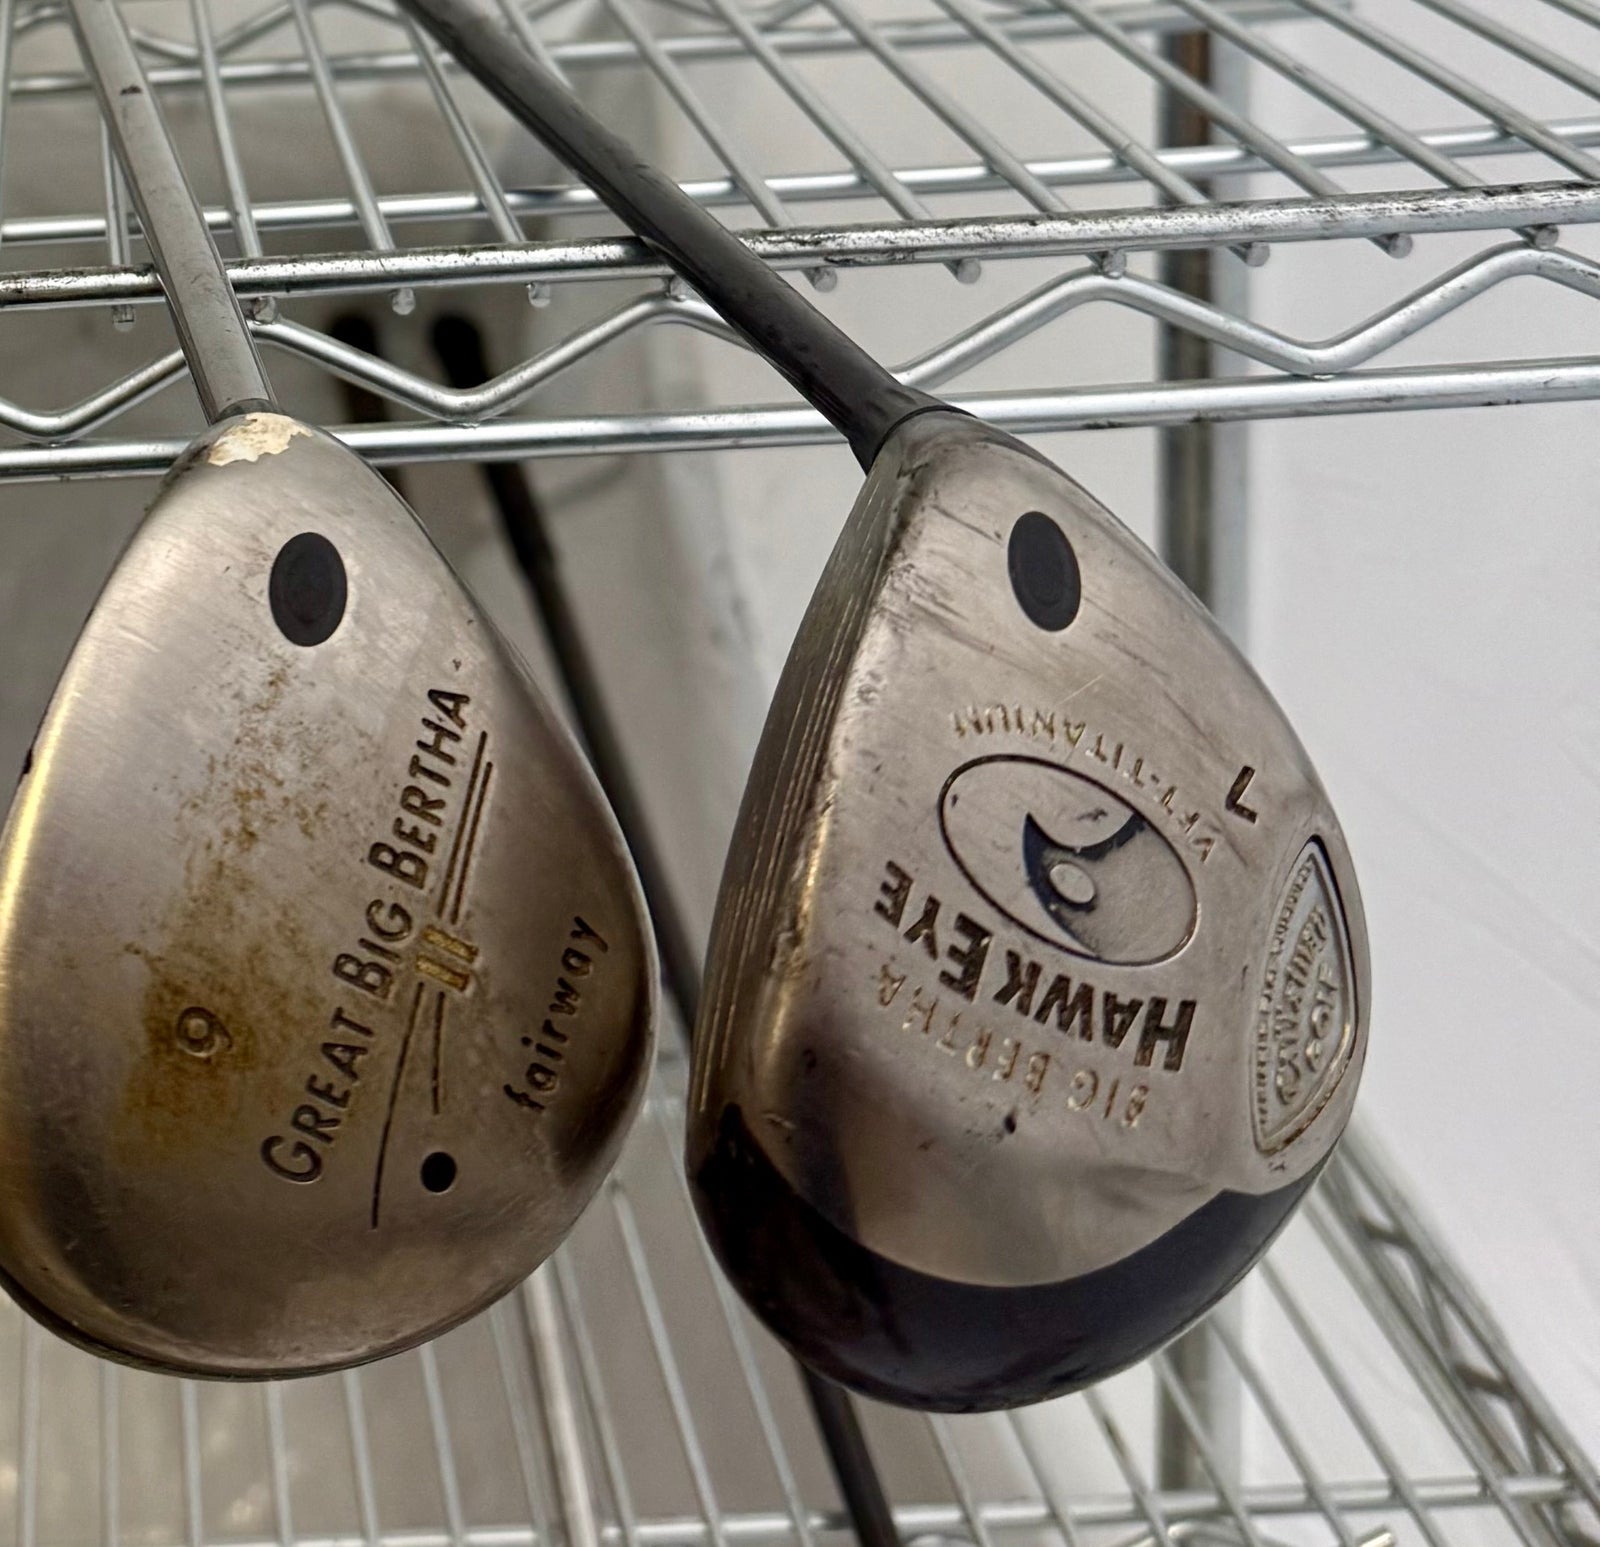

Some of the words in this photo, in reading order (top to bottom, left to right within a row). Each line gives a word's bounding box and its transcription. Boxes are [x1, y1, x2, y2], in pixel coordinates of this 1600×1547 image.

[367, 688, 470, 891] BERTHA
[1225, 765, 1258, 824] 7
[333, 898, 416, 1004] BIG
[503, 916, 608, 1114] fairway
[260, 1006, 374, 1186] GREAT
